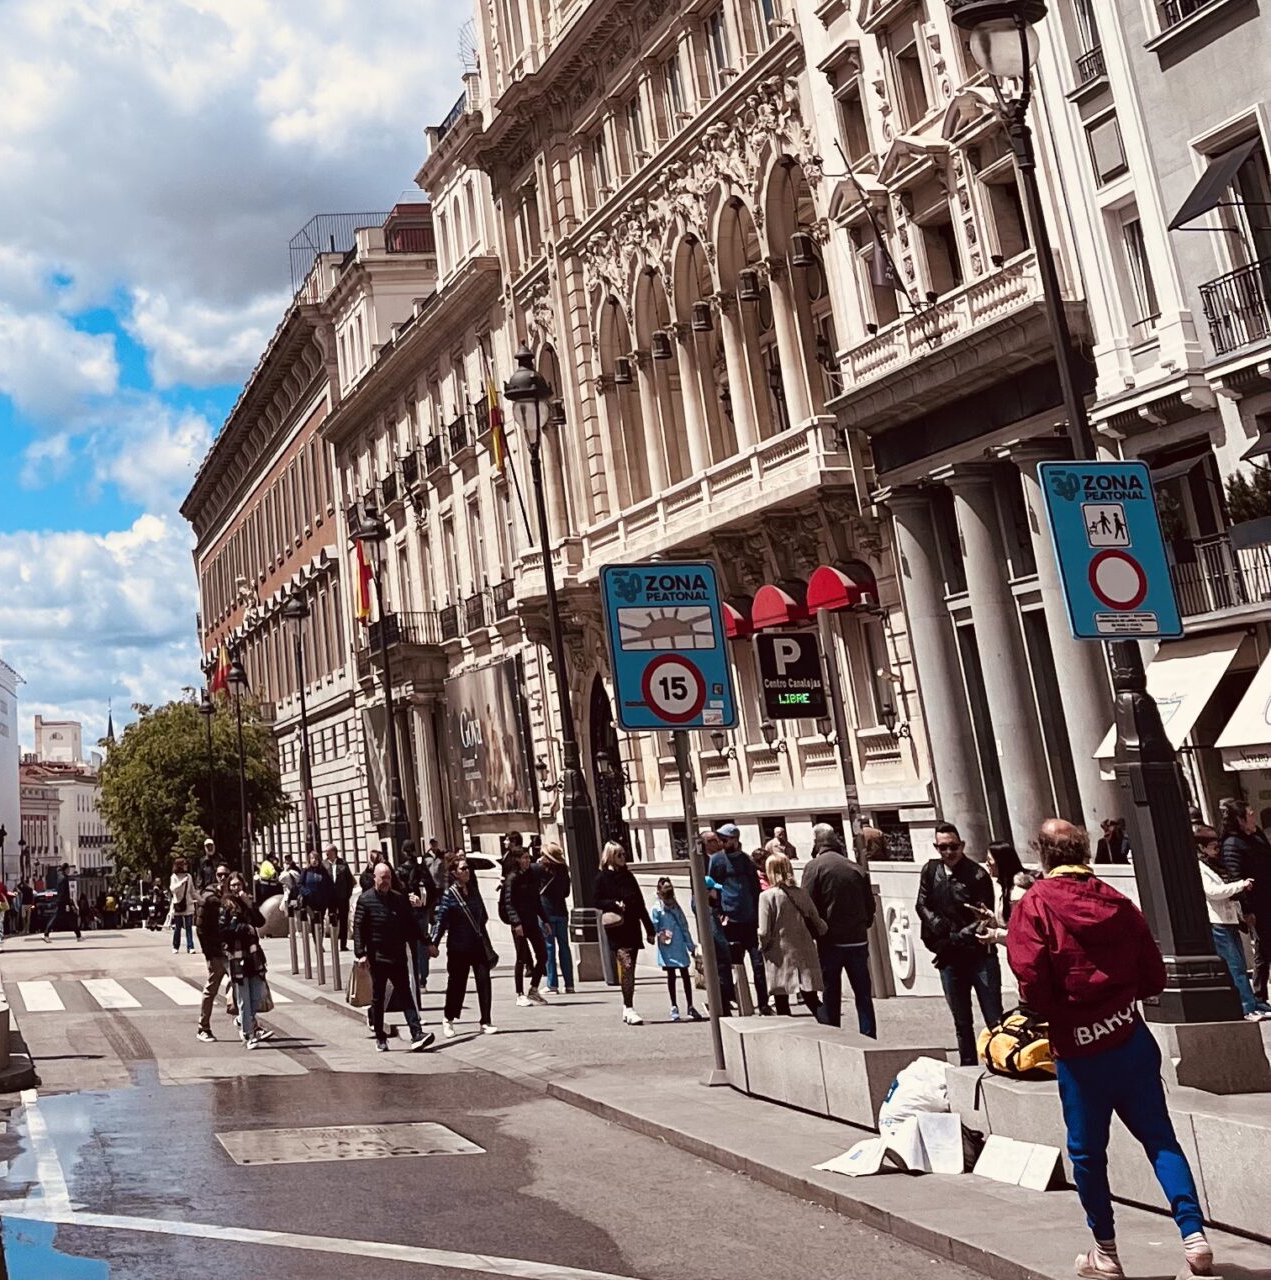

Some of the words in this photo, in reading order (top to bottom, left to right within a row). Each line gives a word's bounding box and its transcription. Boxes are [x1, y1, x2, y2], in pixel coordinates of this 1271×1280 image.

[1081, 475, 1144, 491] ZONA
[1085, 490, 1148, 501] PEATONAL
[644, 574, 709, 592] ZONA
[646, 591, 710, 602] PEATONAL
[773, 638, 801, 676] P
[659, 676, 688, 701] 15
[764, 678, 787, 689] Centro
[788, 678, 821, 690] Canalejas
[778, 693, 810, 705] LIBRE
